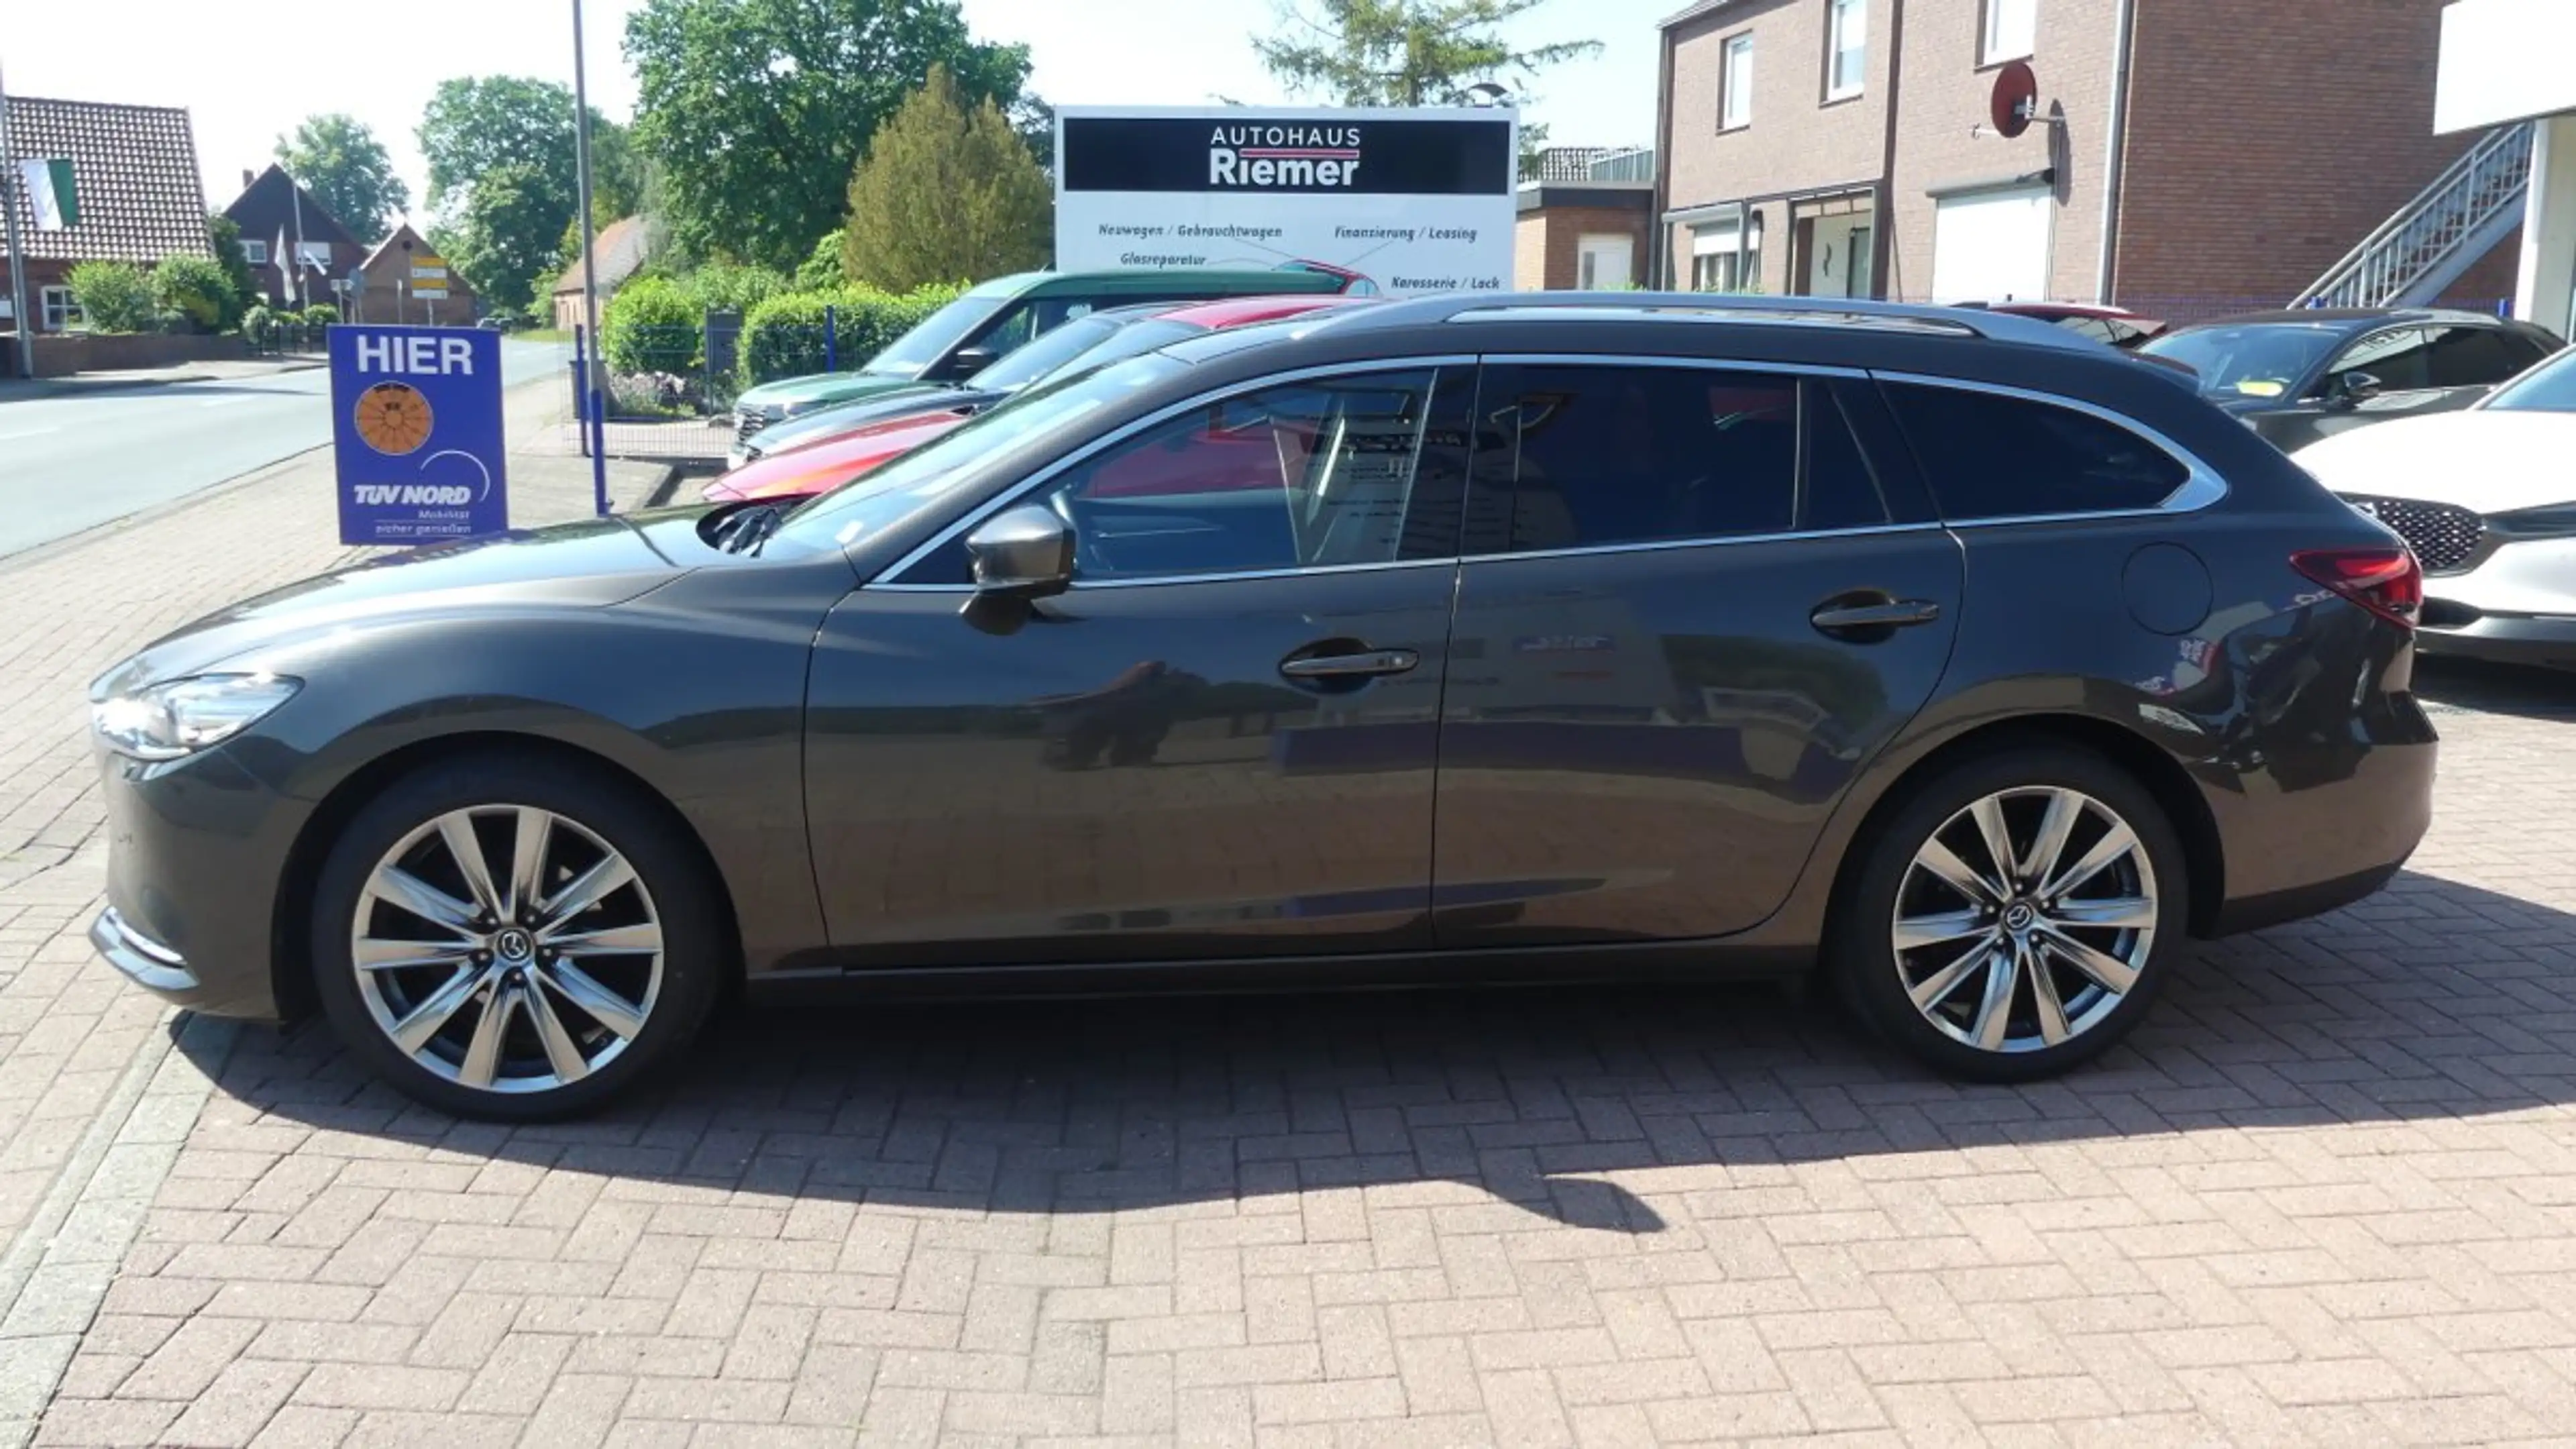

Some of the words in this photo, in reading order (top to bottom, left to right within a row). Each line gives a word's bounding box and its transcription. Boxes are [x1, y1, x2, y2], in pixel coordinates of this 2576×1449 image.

[1210, 126, 1360, 146] AUTOHAUS
[1210, 148, 1360, 186] Riemer
[1098, 224, 1164, 239] Neuwagen
[1177, 225, 1283, 241] Gebrauchtwagen
[1335, 225, 1415, 243] Finanzierung
[1428, 226, 1478, 244] Leasing
[1120, 252, 1208, 268] Glasreparatur
[1391, 275, 1457, 289] Karosserie
[1470, 276, 1500, 289] Lack
[357, 335, 474, 375] HIER
[401, 485, 472, 506] NORD
